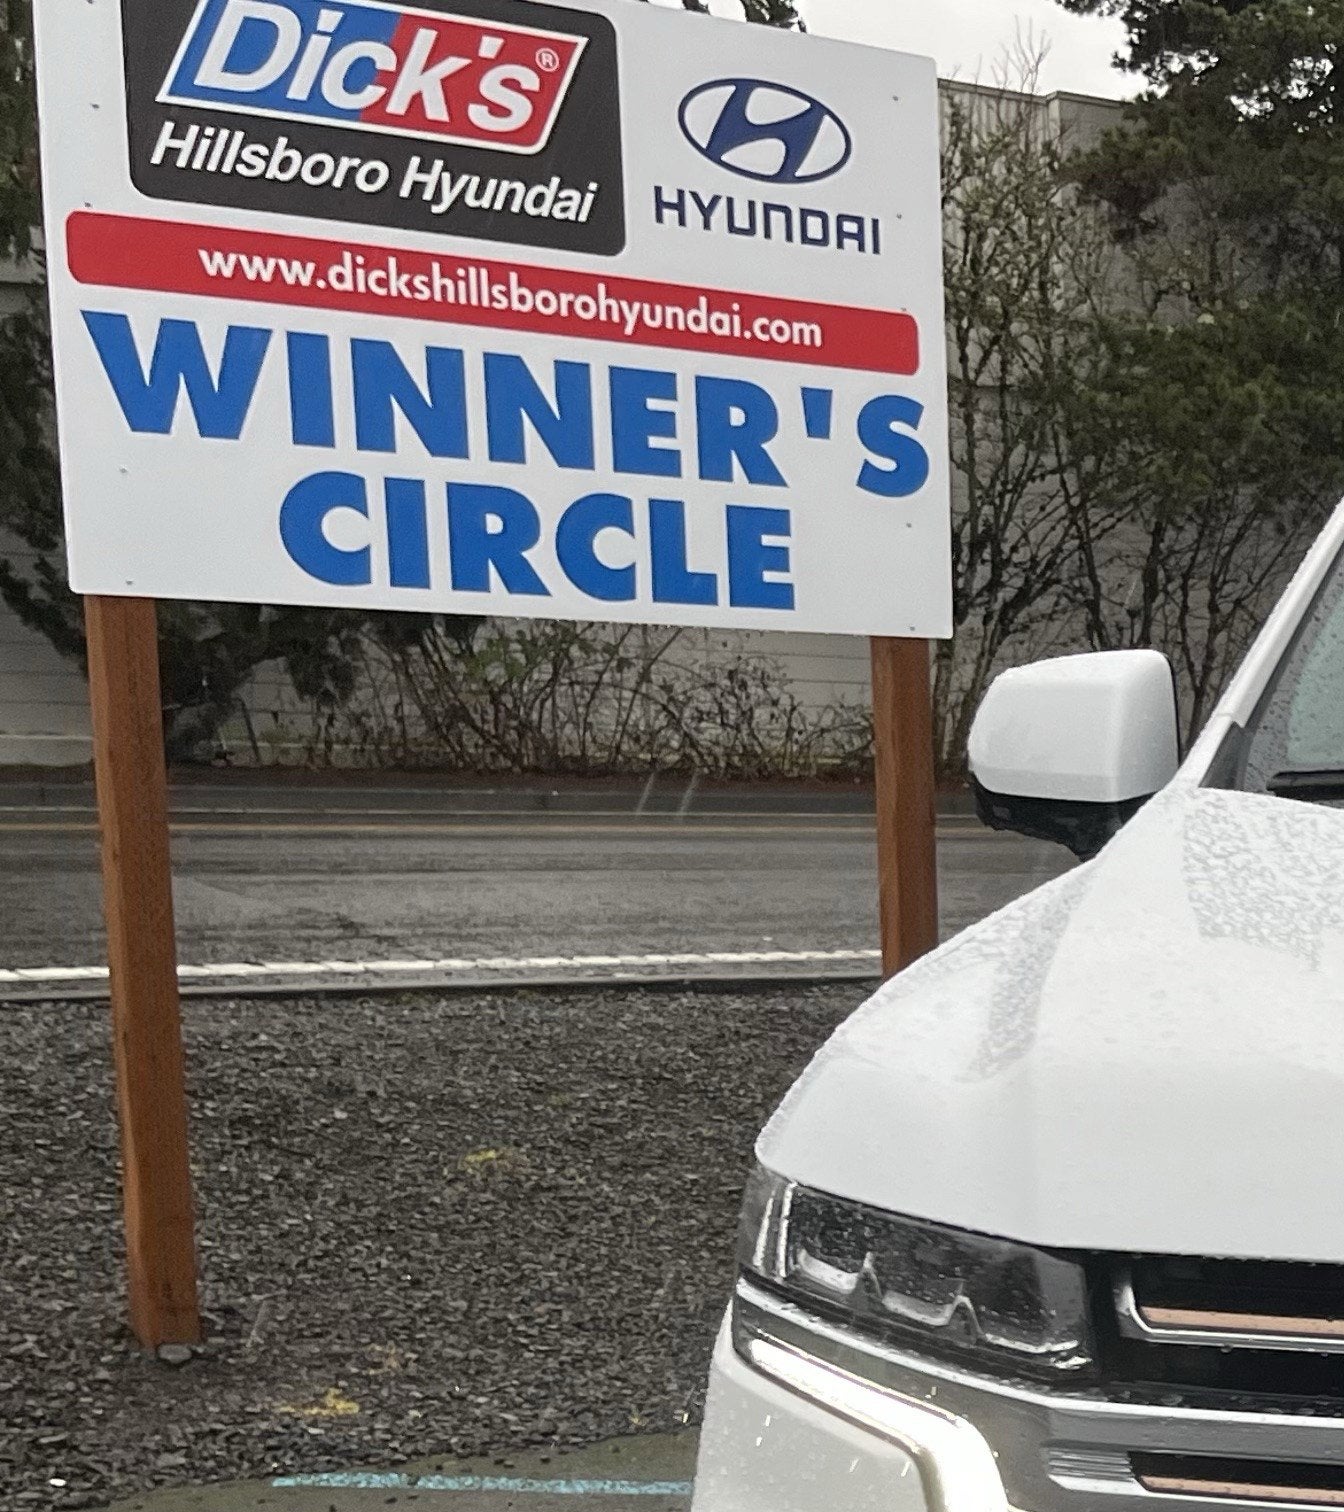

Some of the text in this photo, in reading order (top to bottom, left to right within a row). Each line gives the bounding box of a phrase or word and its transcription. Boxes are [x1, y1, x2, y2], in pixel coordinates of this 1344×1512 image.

[149, 121, 599, 224] Hillsboro Hyundai
[653, 185, 881, 255] HYUNDAI
[198, 246, 823, 349] www.dickshillsborohyundai.com
[81, 310, 929, 498] WINNER'S
[280, 470, 797, 611] CIRCLE
